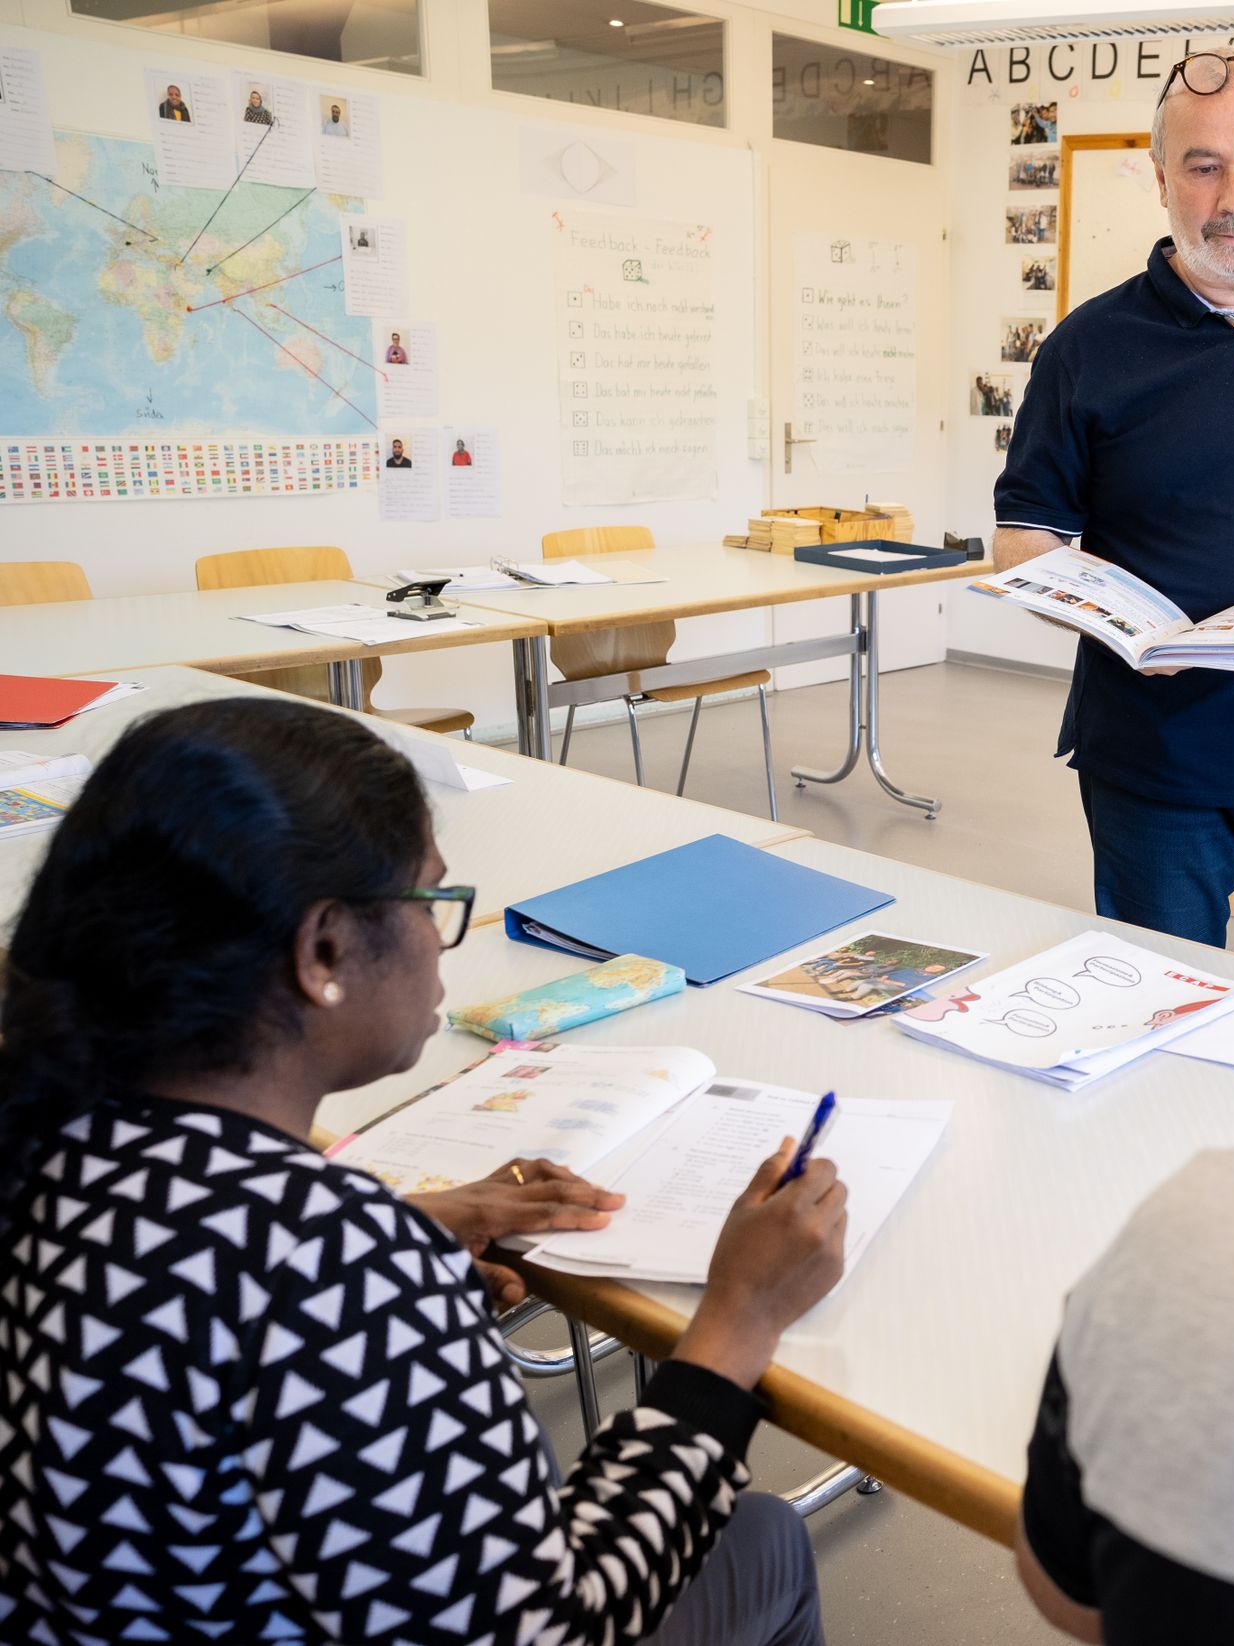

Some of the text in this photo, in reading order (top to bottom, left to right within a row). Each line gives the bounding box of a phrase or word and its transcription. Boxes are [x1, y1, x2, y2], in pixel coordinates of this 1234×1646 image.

[967, 48, 993, 85] A
[1008, 45, 1031, 84] B
[1047, 44, 1075, 82] C
[1092, 42, 1118, 80] D
[1136, 40, 1162, 79] E
